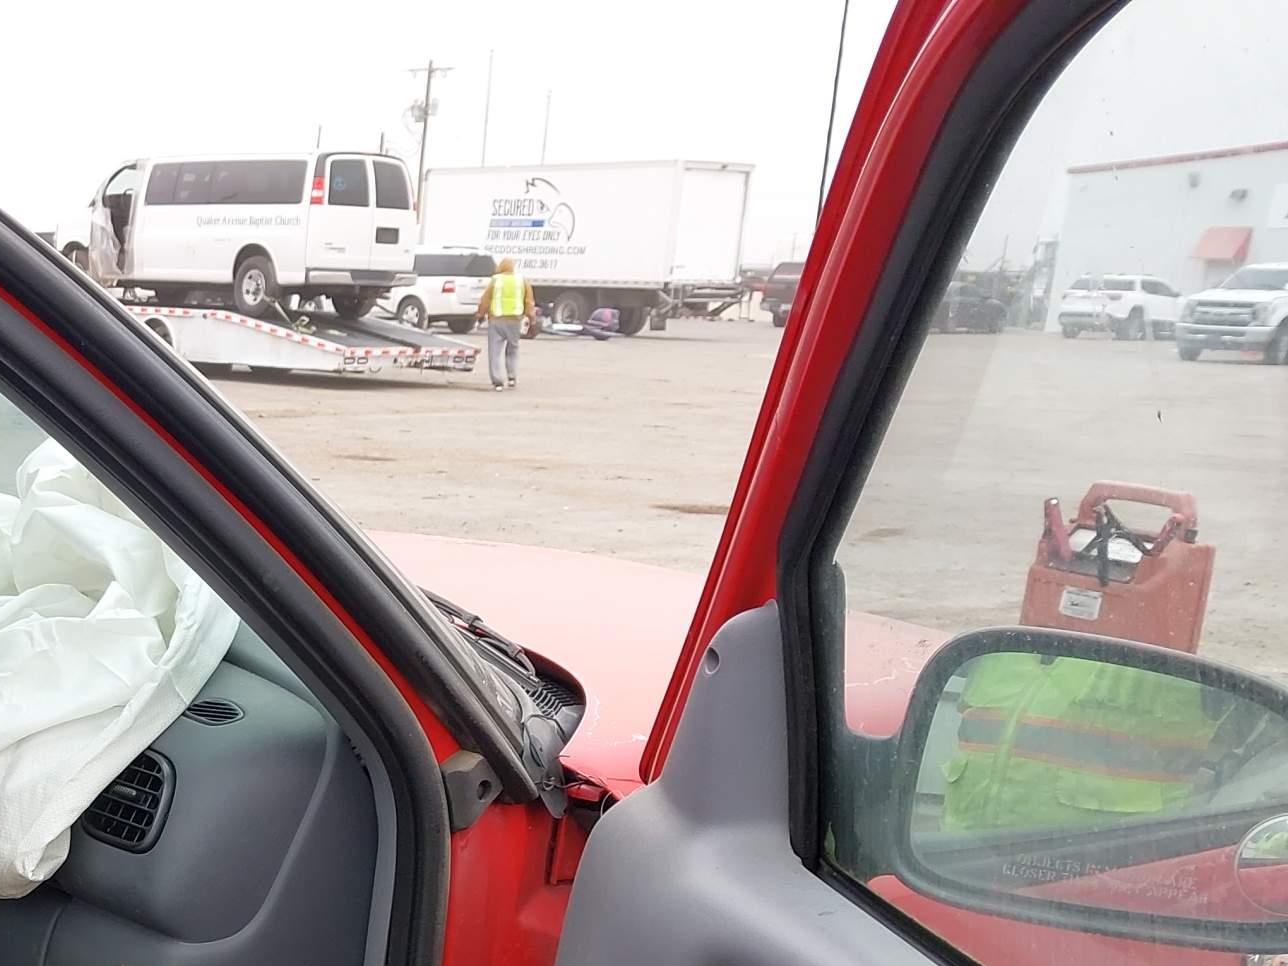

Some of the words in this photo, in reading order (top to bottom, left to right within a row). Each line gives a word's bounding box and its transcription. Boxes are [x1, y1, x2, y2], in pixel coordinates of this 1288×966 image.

[492, 199, 535, 216] SECURED
[196, 216, 220, 227] Quaker
[222, 216, 248, 226] Avenue
[249, 216, 273, 228] Baptist
[274, 216, 301, 226] Church
[487, 230, 501, 240] FOR
[503, 230, 521, 241] YOUR
[522, 230, 540, 241] EYES
[542, 230, 560, 241] ONLY
